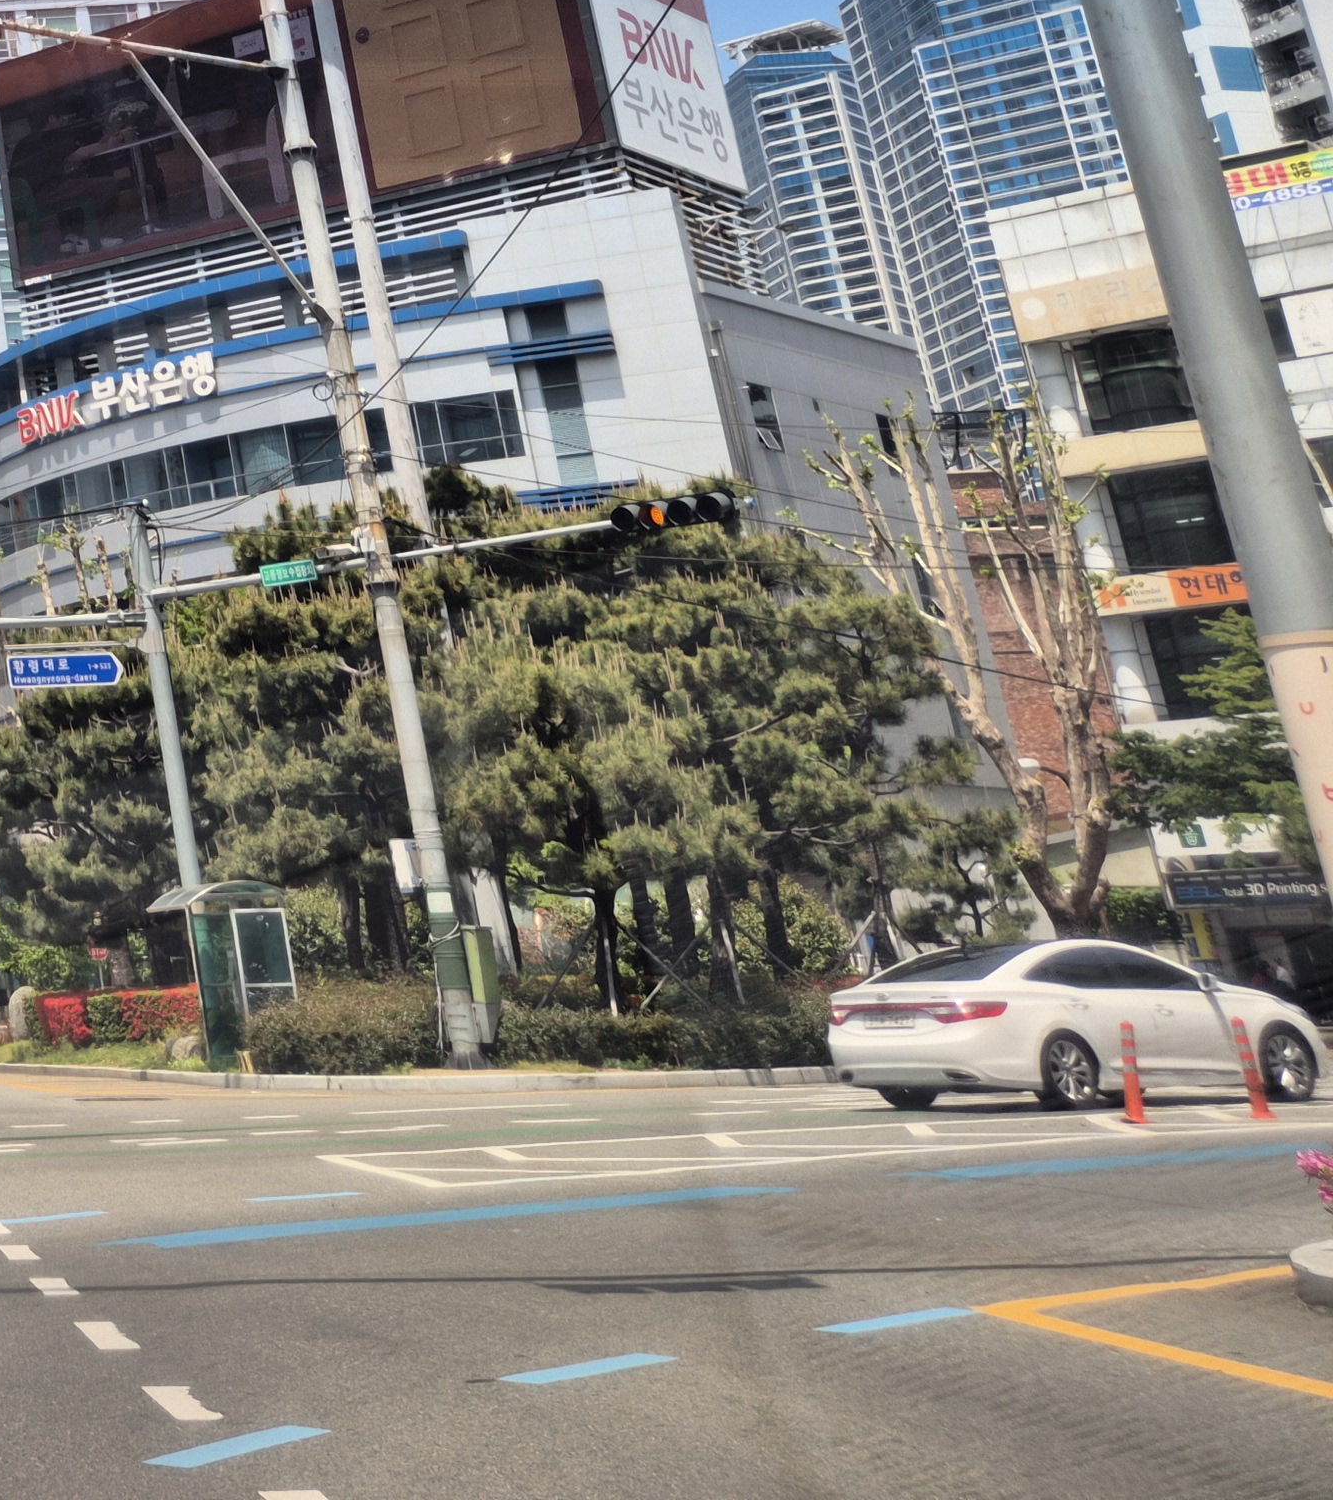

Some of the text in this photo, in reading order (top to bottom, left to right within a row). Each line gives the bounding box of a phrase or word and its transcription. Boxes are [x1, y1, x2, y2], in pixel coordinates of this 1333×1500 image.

[616, 7, 706, 91] BNK
[622, 75, 729, 163] 부산은행
[89, 350, 216, 420] 부산은행
[17, 390, 85, 445] BNK
[12, 658, 70, 675] 황령대로
[13, 673, 98, 685] Hwangnyeong-daero
[1222, 887, 1244, 897] Total
[1244, 883, 1264, 896] 3D
[1266, 881, 1318, 897] Printing
